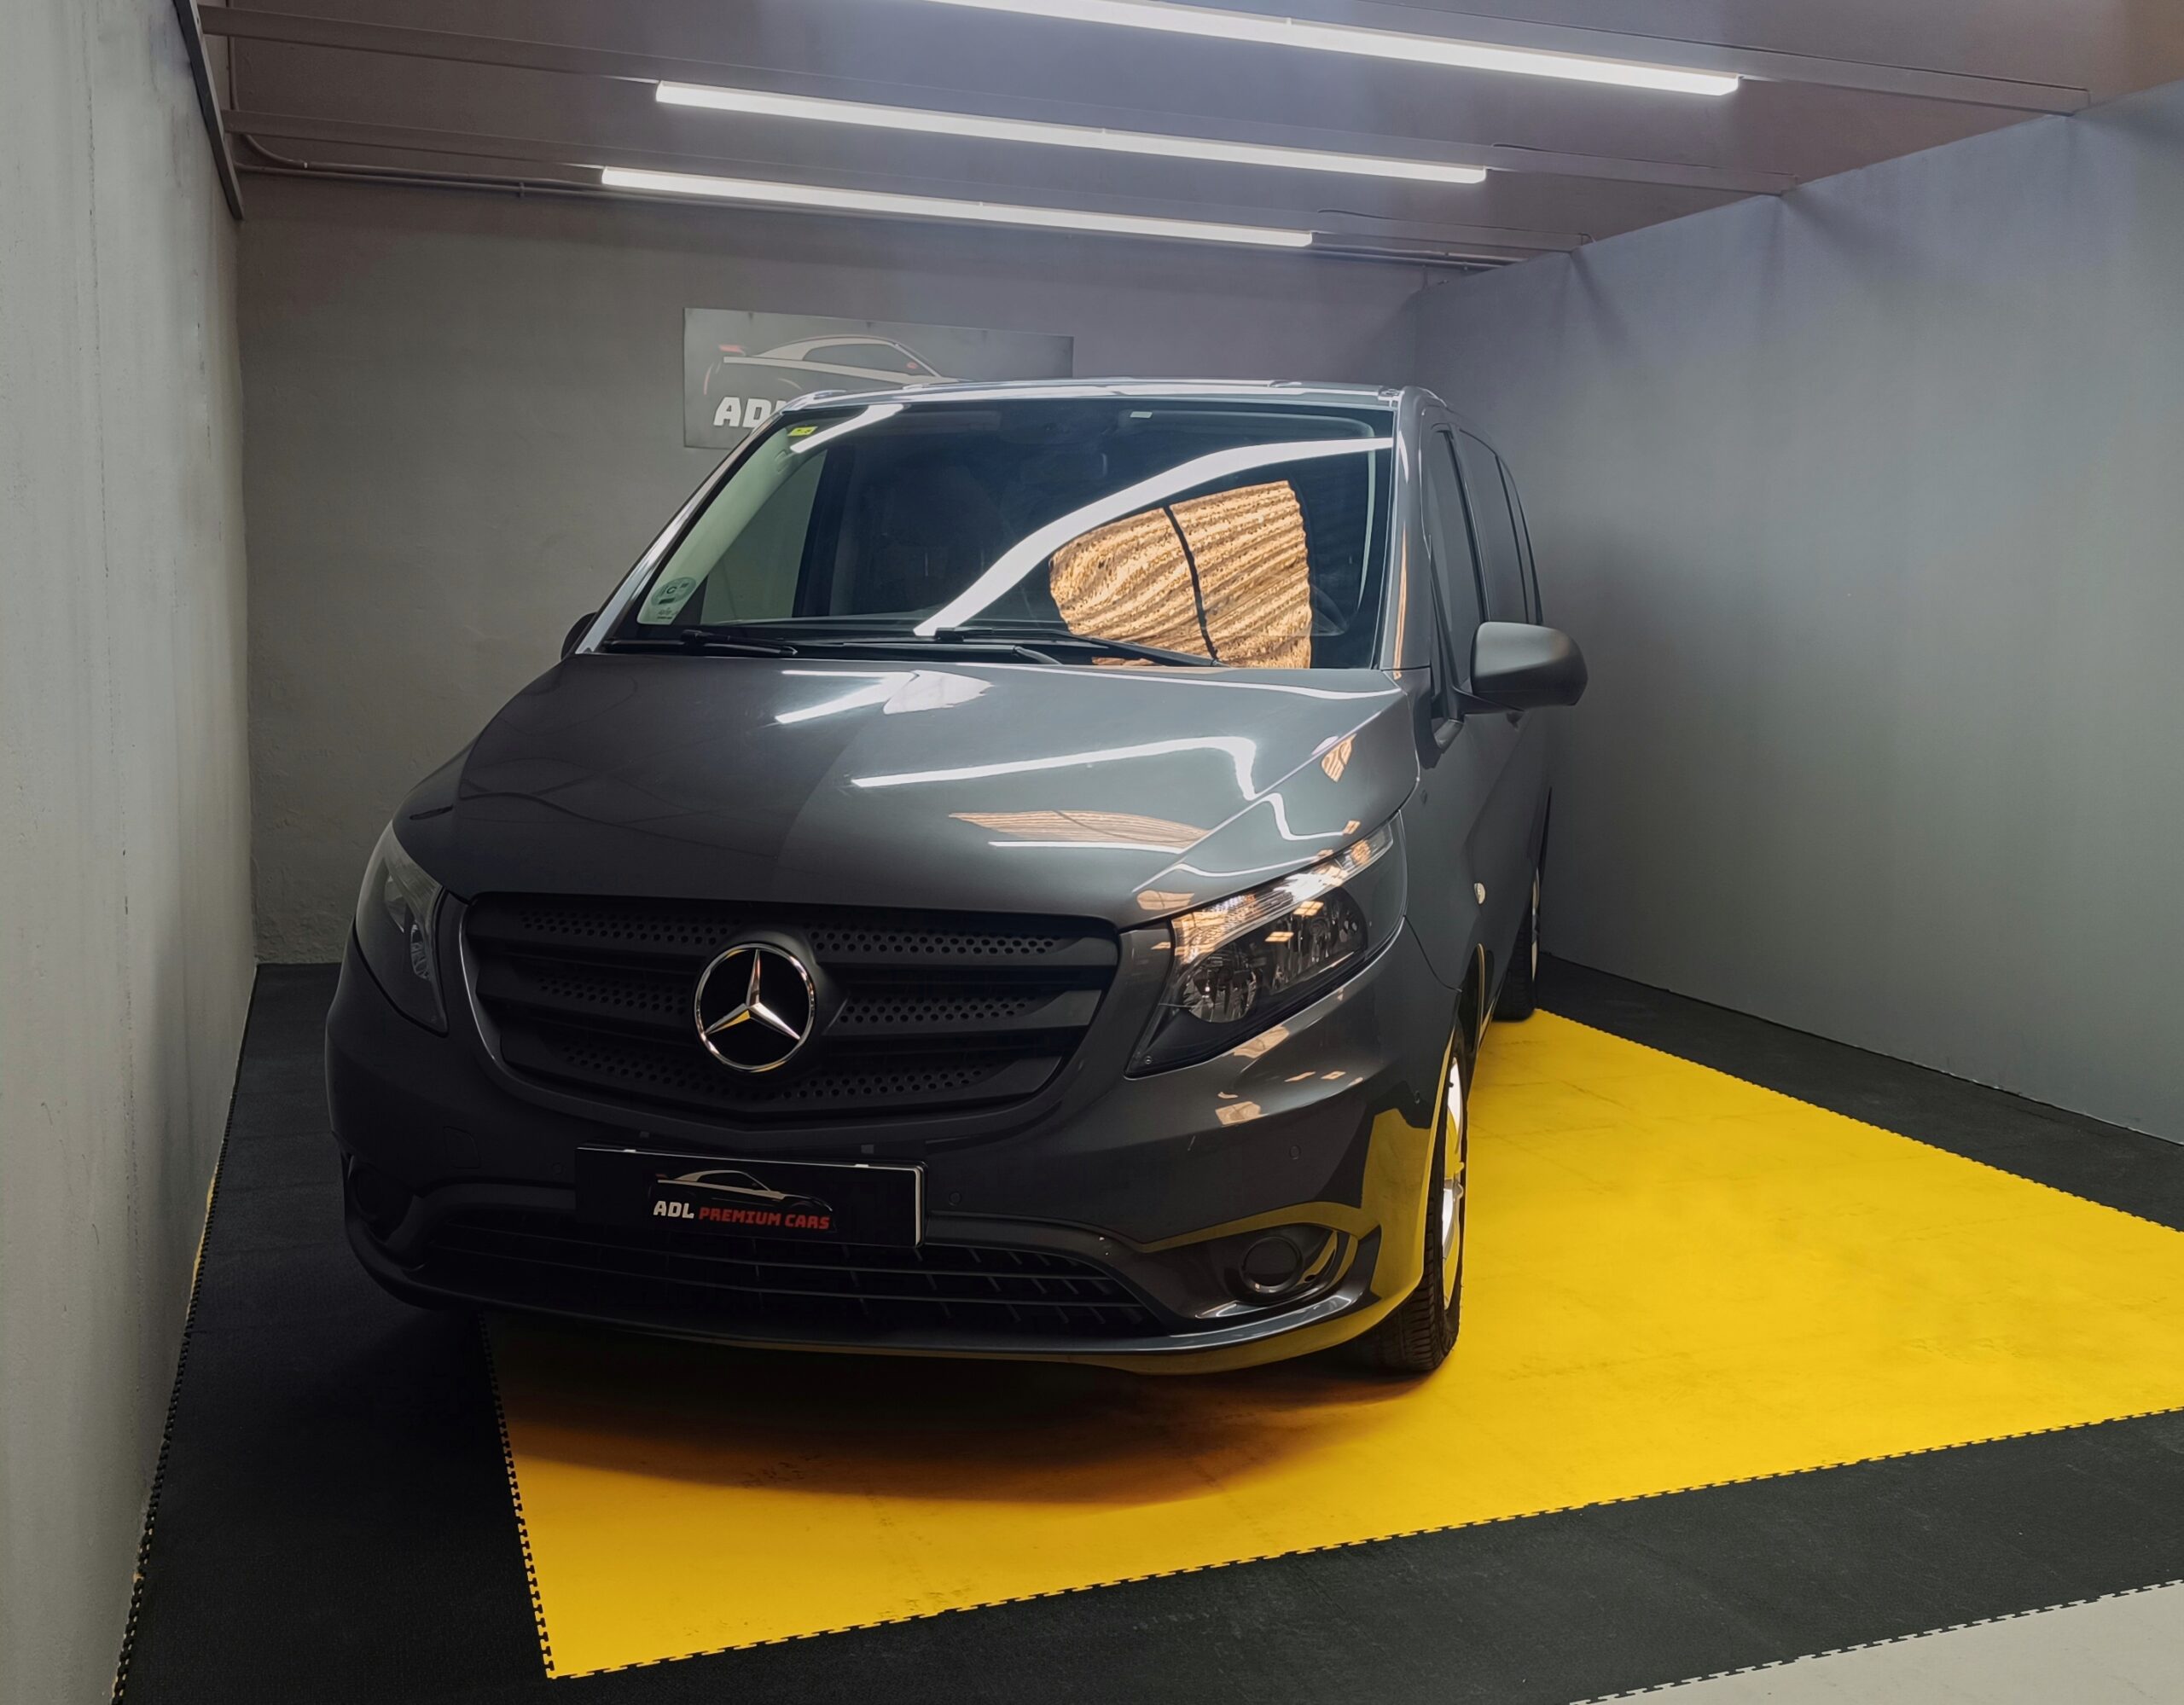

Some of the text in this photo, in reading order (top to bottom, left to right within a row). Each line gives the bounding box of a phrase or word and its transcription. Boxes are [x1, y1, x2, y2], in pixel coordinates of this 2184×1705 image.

[653, 1200, 831, 1229] ADL PREMIUM CARS
